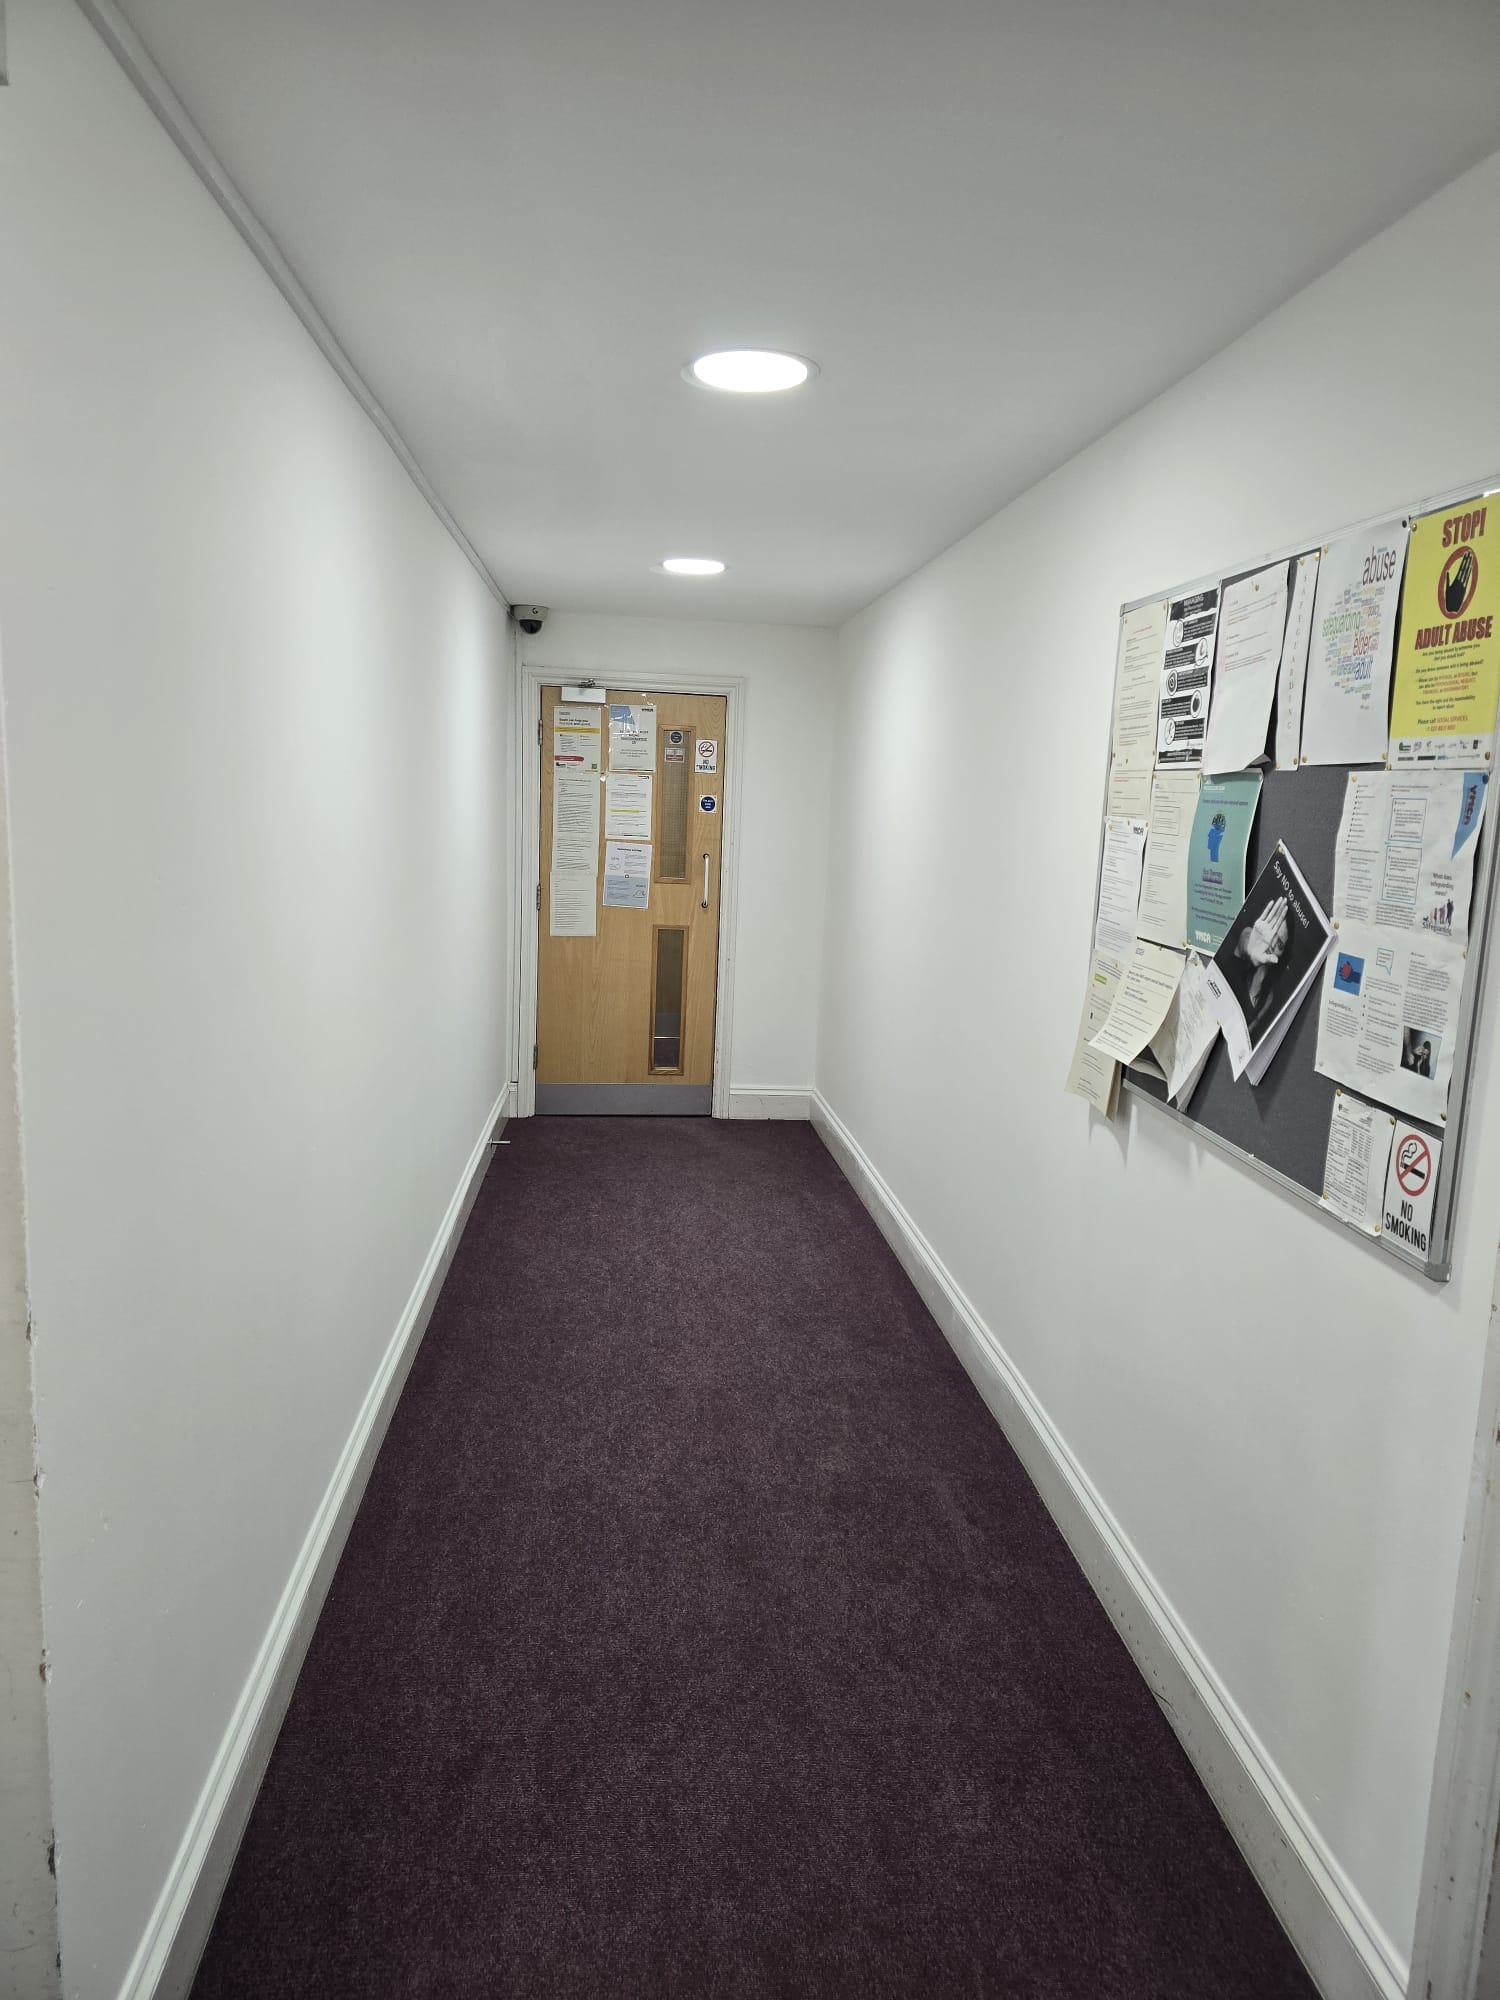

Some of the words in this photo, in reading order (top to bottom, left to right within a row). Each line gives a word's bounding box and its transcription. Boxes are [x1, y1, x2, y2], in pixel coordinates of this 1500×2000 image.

[1442, 507, 1487, 548] STOP!
[1362, 546, 1396, 586] abuse
[1321, 611, 1361, 642] safeguarding
[1414, 622, 1451, 650] ADULT
[1453, 615, 1493, 642] ABUSE
[1352, 632, 1373, 658] elder
[1355, 656, 1374, 680] adult
[1274, 860, 1283, 879] Say
[1281, 874, 1290, 891] NO
[1288, 888, 1295, 901] to
[1400, 1199, 1414, 1222] NO
[1385, 1212, 1427, 1252] SMOKING
